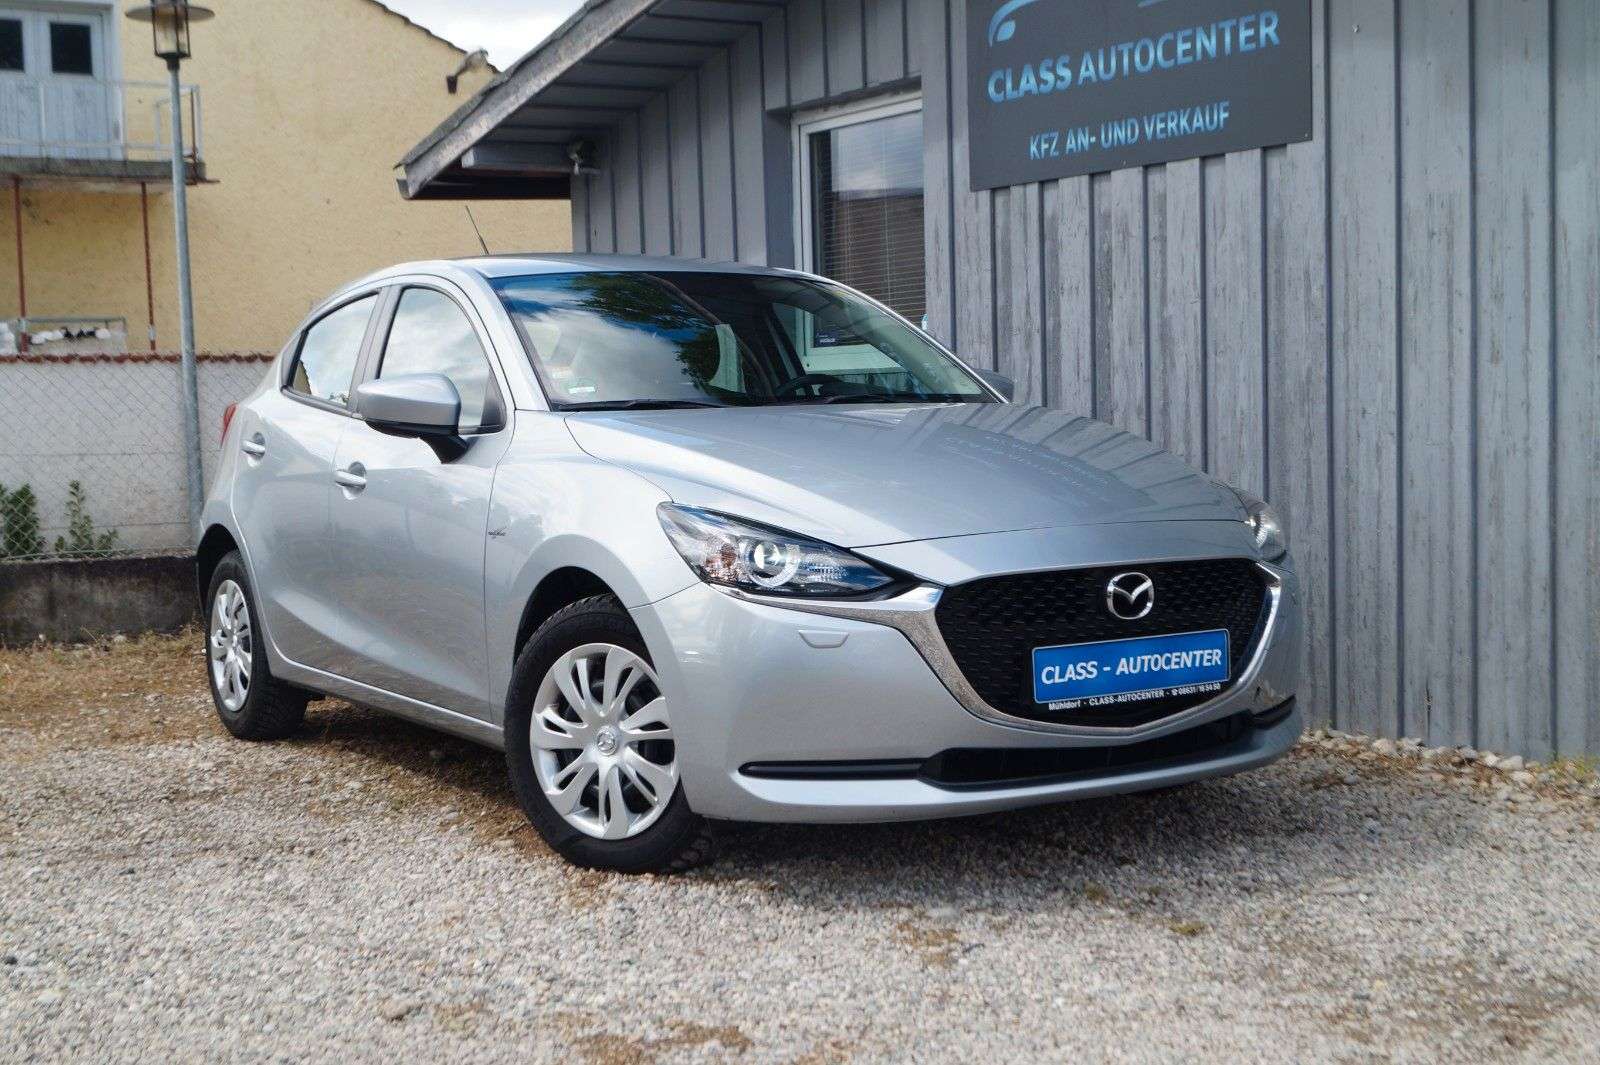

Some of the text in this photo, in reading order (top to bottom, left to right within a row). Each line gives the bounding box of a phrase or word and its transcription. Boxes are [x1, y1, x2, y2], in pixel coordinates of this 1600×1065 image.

[987, 10, 1281, 104] CLASS AUTOCENTER
[1029, 101, 1231, 160] KFZ AN- UND VERKAUF
[1041, 660, 1098, 685] CLASS
[1115, 648, 1222, 676] AUTOCENTER
[1048, 700, 1081, 711] Mühldorf
